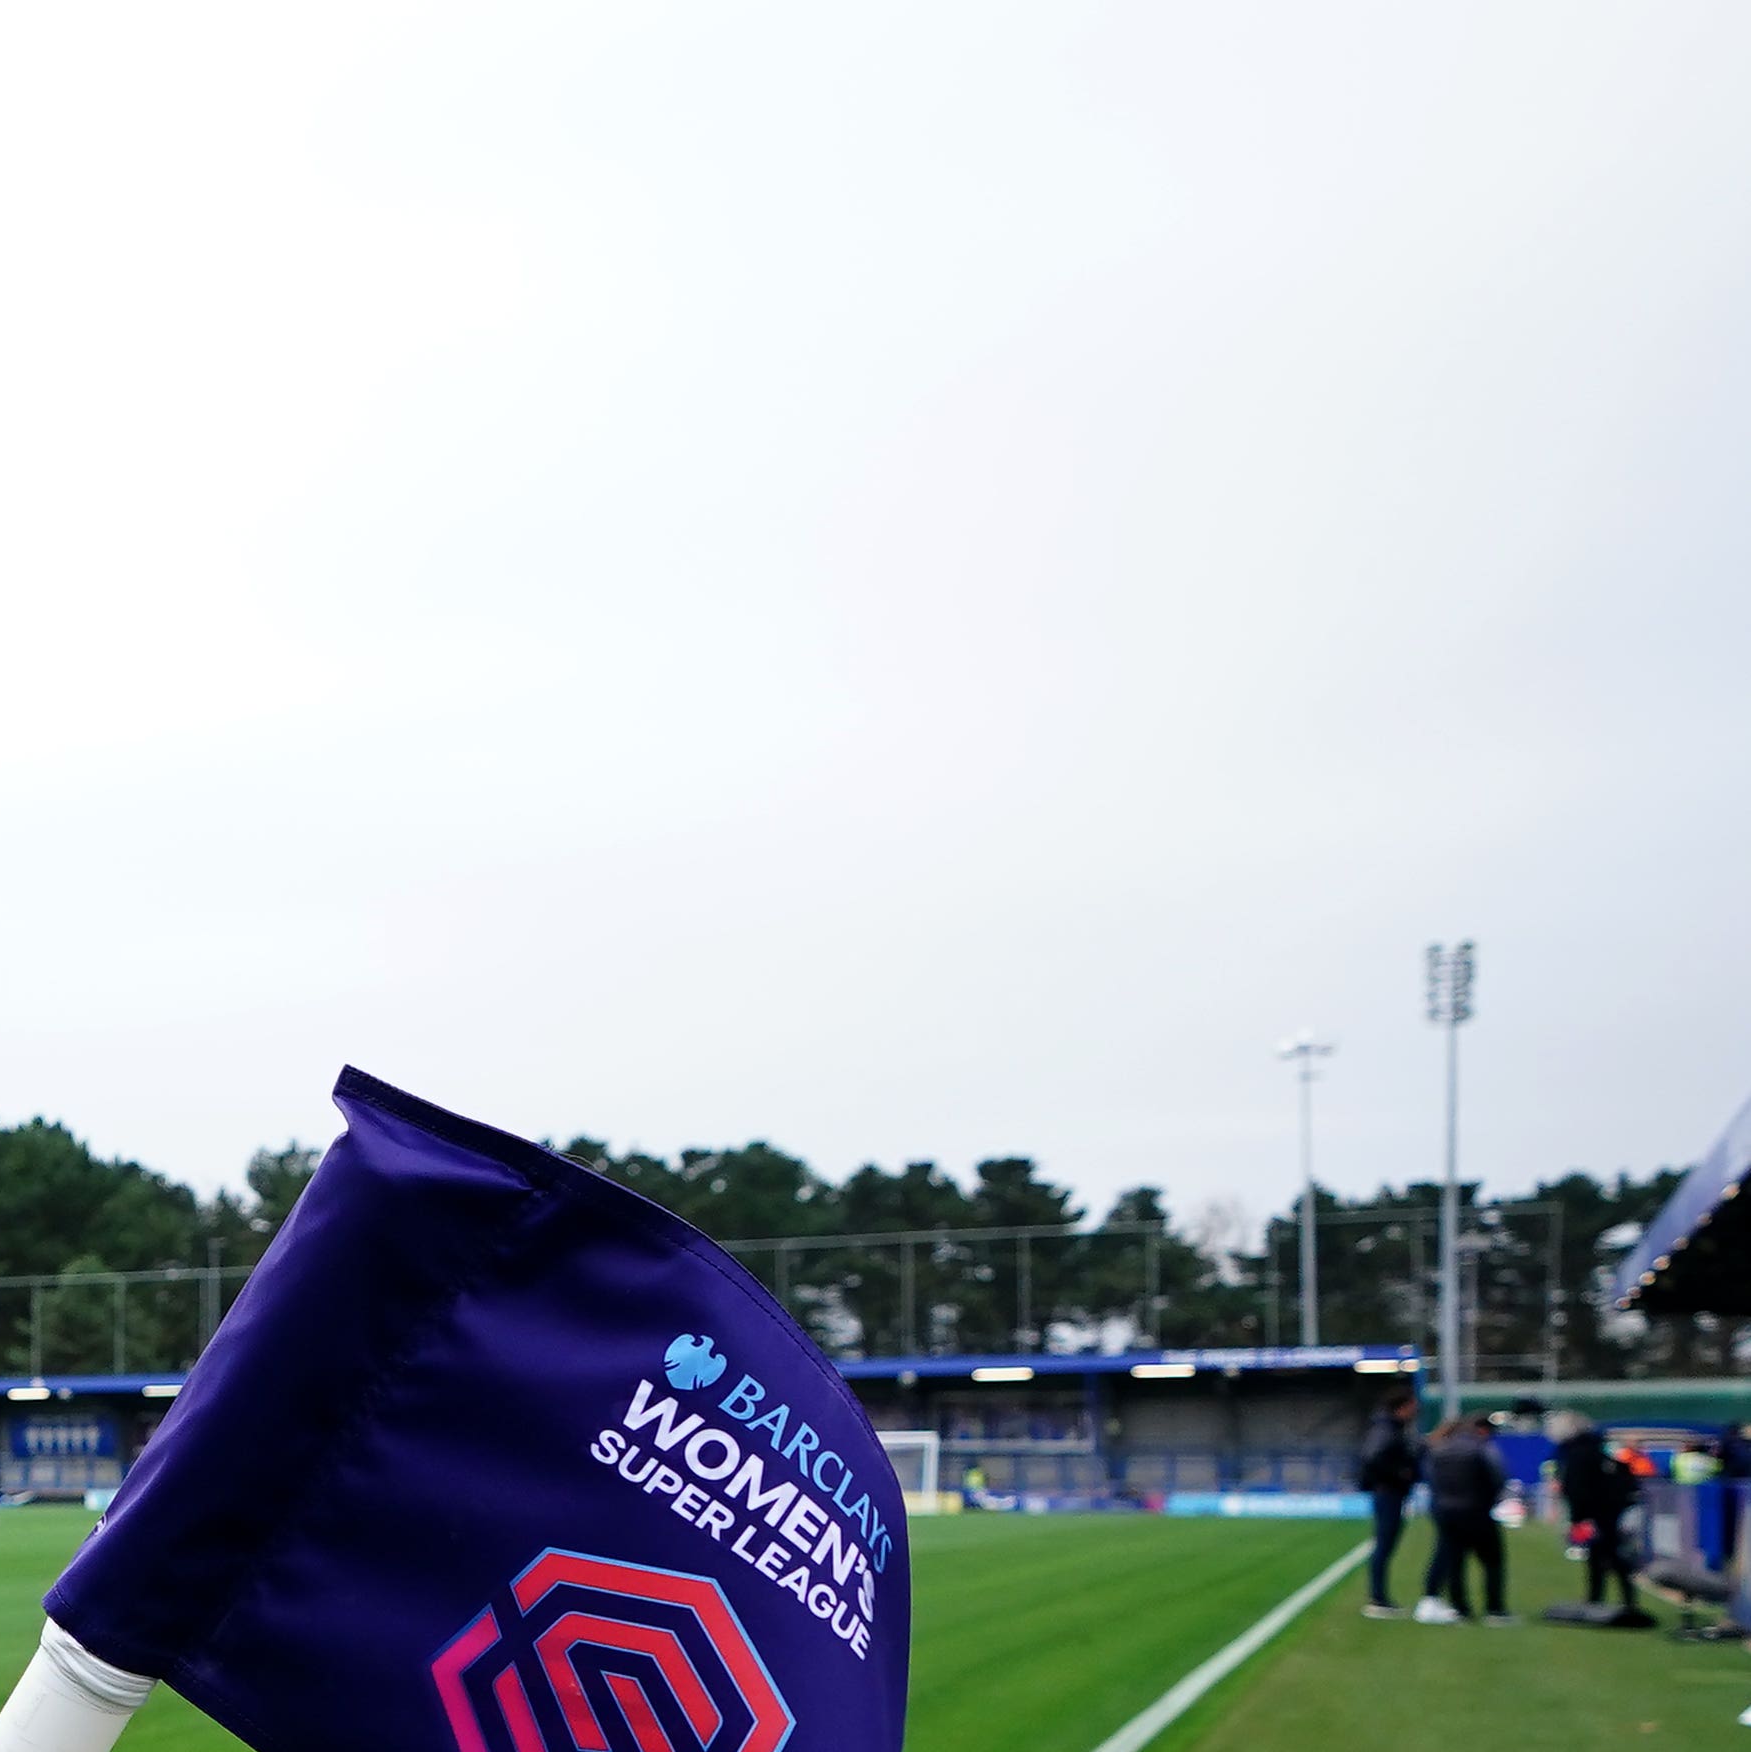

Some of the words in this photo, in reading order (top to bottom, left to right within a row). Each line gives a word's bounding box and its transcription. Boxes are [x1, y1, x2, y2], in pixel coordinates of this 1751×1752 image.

[590, 1429, 736, 1542] SUPER
[730, 1524, 872, 1661] LEAGUE
[623, 1379, 876, 1623] WOMEN'S
[718, 1374, 892, 1574] BARCLAYS
